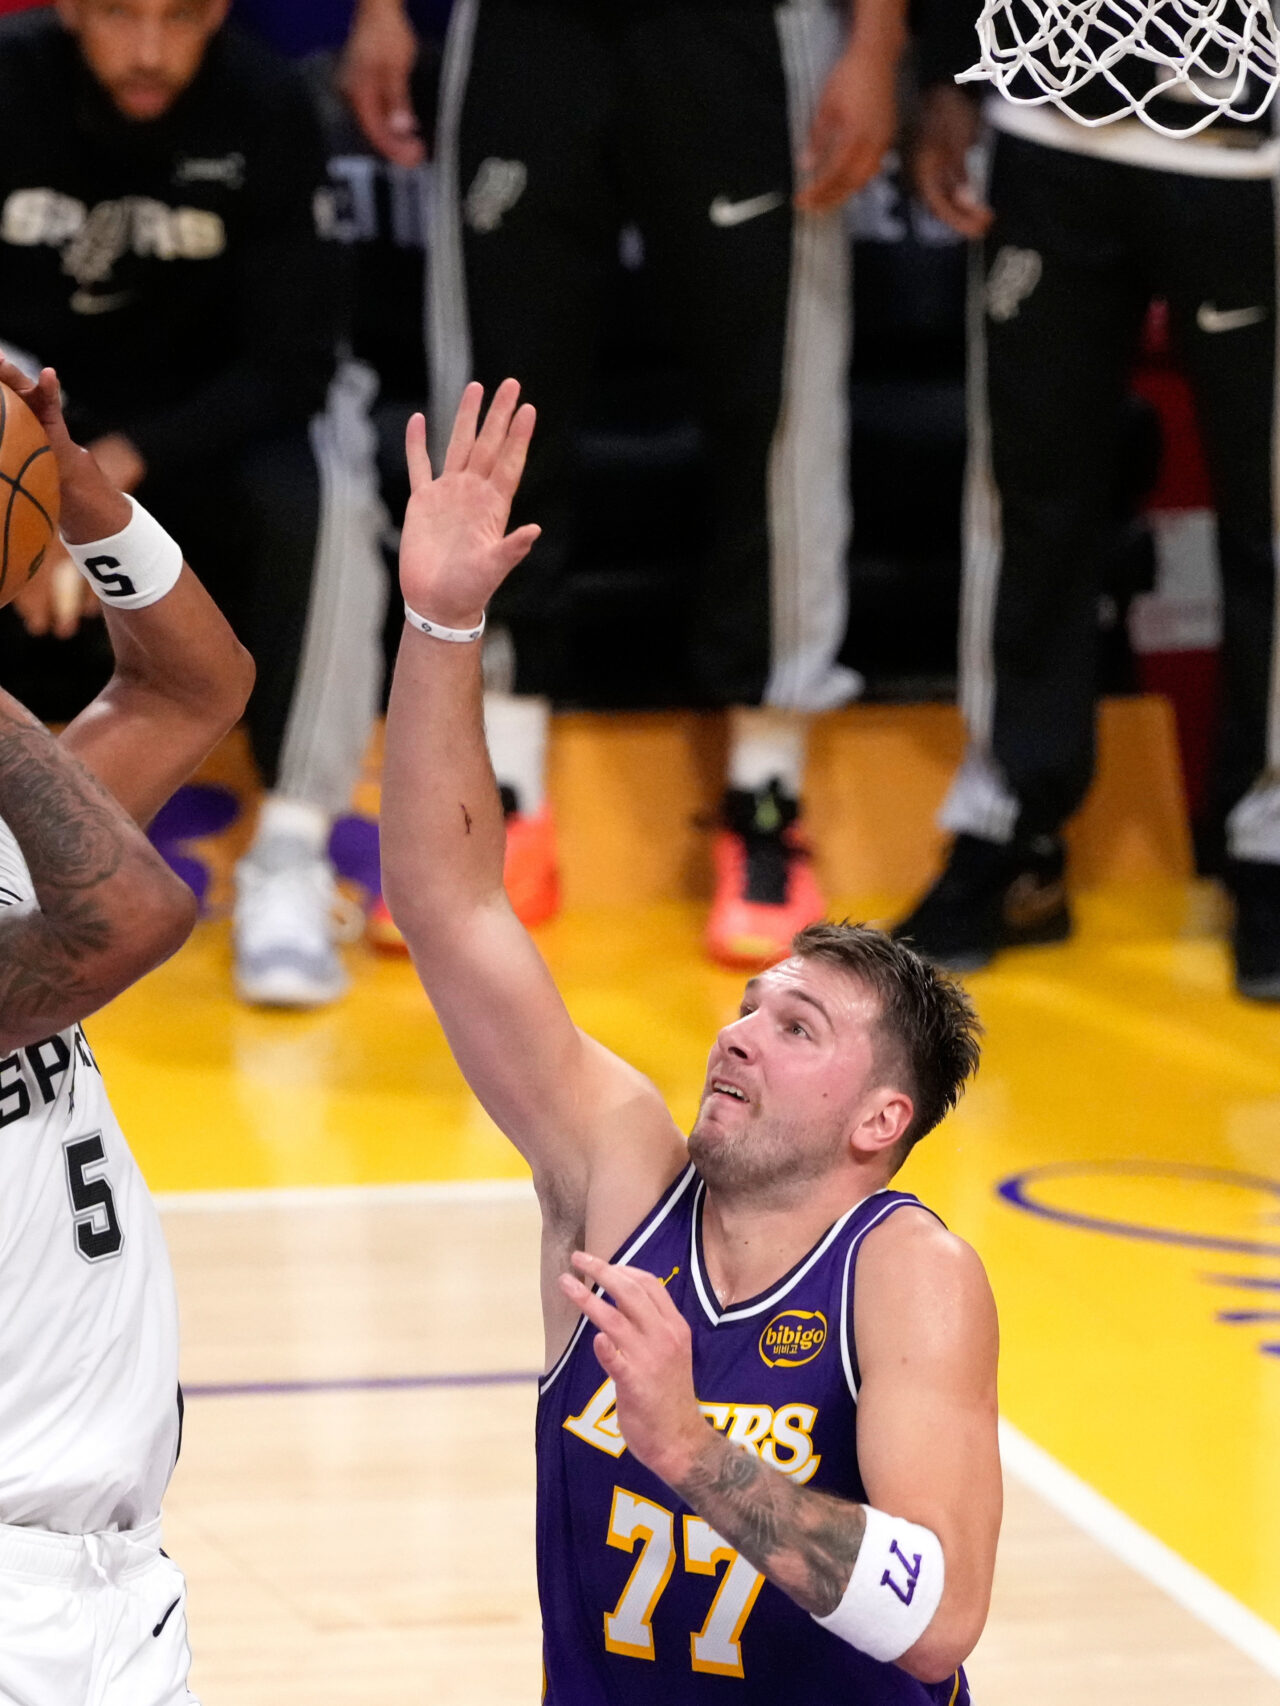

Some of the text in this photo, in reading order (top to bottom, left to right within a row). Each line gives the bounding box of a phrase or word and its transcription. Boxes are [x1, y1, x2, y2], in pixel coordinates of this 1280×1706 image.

[84, 555, 138, 597] S
[62, 1129, 125, 1264] 5
[766, 1325, 825, 1350] bibigo
[603, 1485, 767, 1680] 77
[880, 1538, 922, 1607] 77
